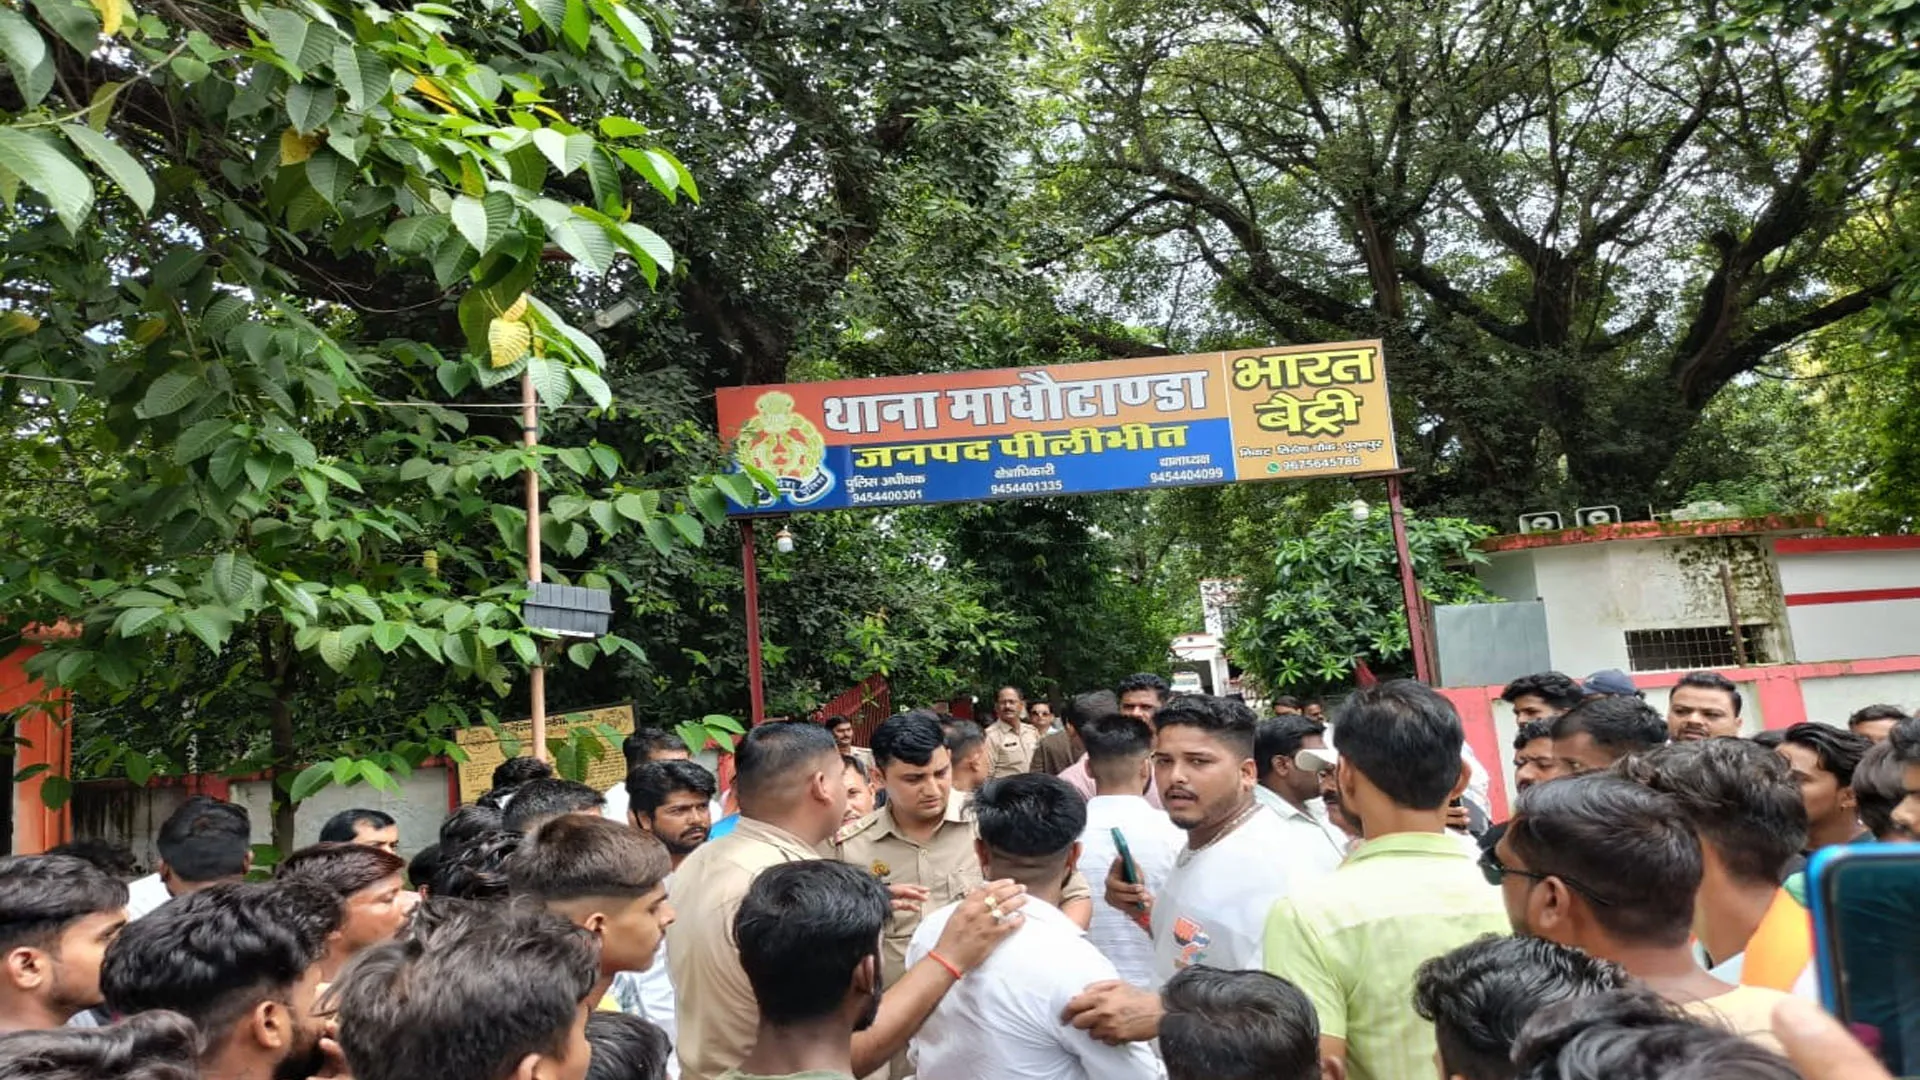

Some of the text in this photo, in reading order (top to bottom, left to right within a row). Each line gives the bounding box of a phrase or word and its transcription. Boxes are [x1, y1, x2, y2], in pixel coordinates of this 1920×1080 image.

[1233, 347, 1377, 390] भारत
[824, 370, 1209, 433] थाना माधौटाण्डा
[1254, 387, 1364, 437] बैट्री
[852, 423, 1189, 468] जनपद पीलीभीत
[1282, 456, 1361, 471] 9675645786
[845, 472, 926, 493] पुलिस अधीक्षक
[1150, 467, 1224, 483] 9454404099
[852, 489, 923, 504] 9454400301
[991, 480, 1063, 495] 9454401335
